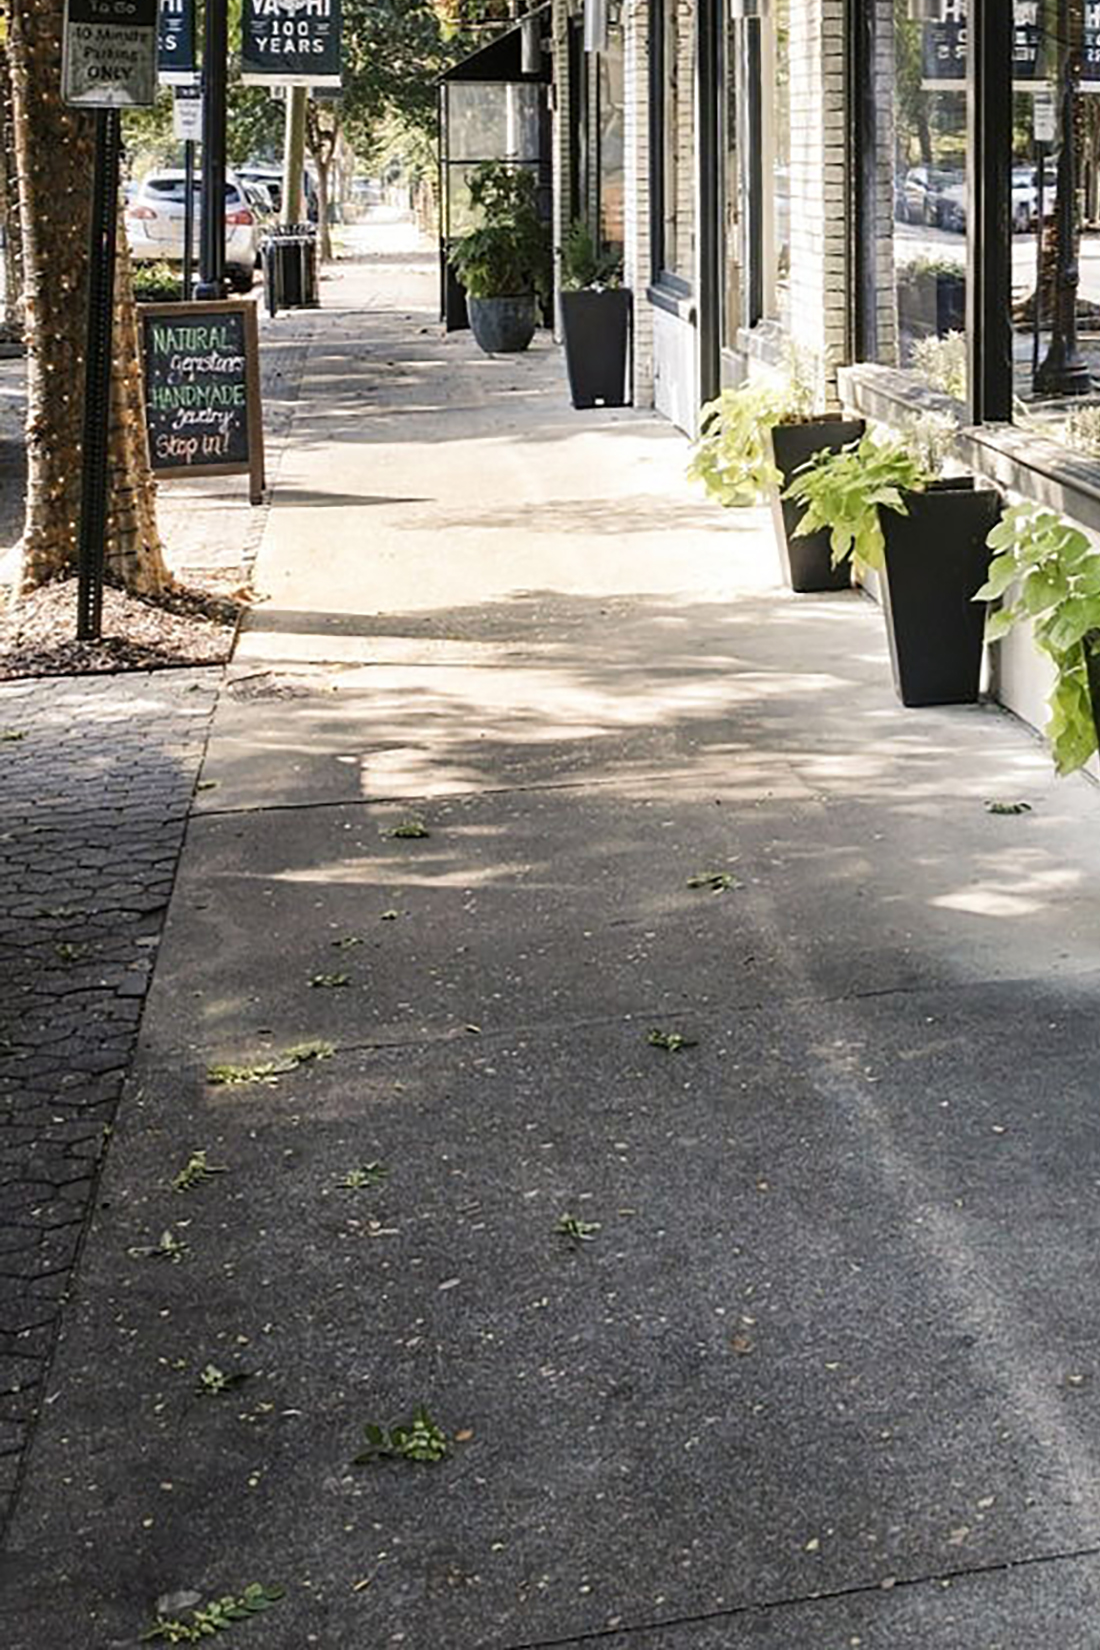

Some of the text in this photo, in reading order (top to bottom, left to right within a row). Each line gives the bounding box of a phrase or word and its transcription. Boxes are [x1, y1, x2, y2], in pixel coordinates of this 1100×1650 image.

[272, 21, 308, 36] 100
[255, 37, 324, 53] YEARS
[87, 66, 132, 81] ONLY
[153, 326, 233, 354] NATURAL
[153, 384, 246, 409] HANDMADE
[156, 434, 198, 464] Stop
